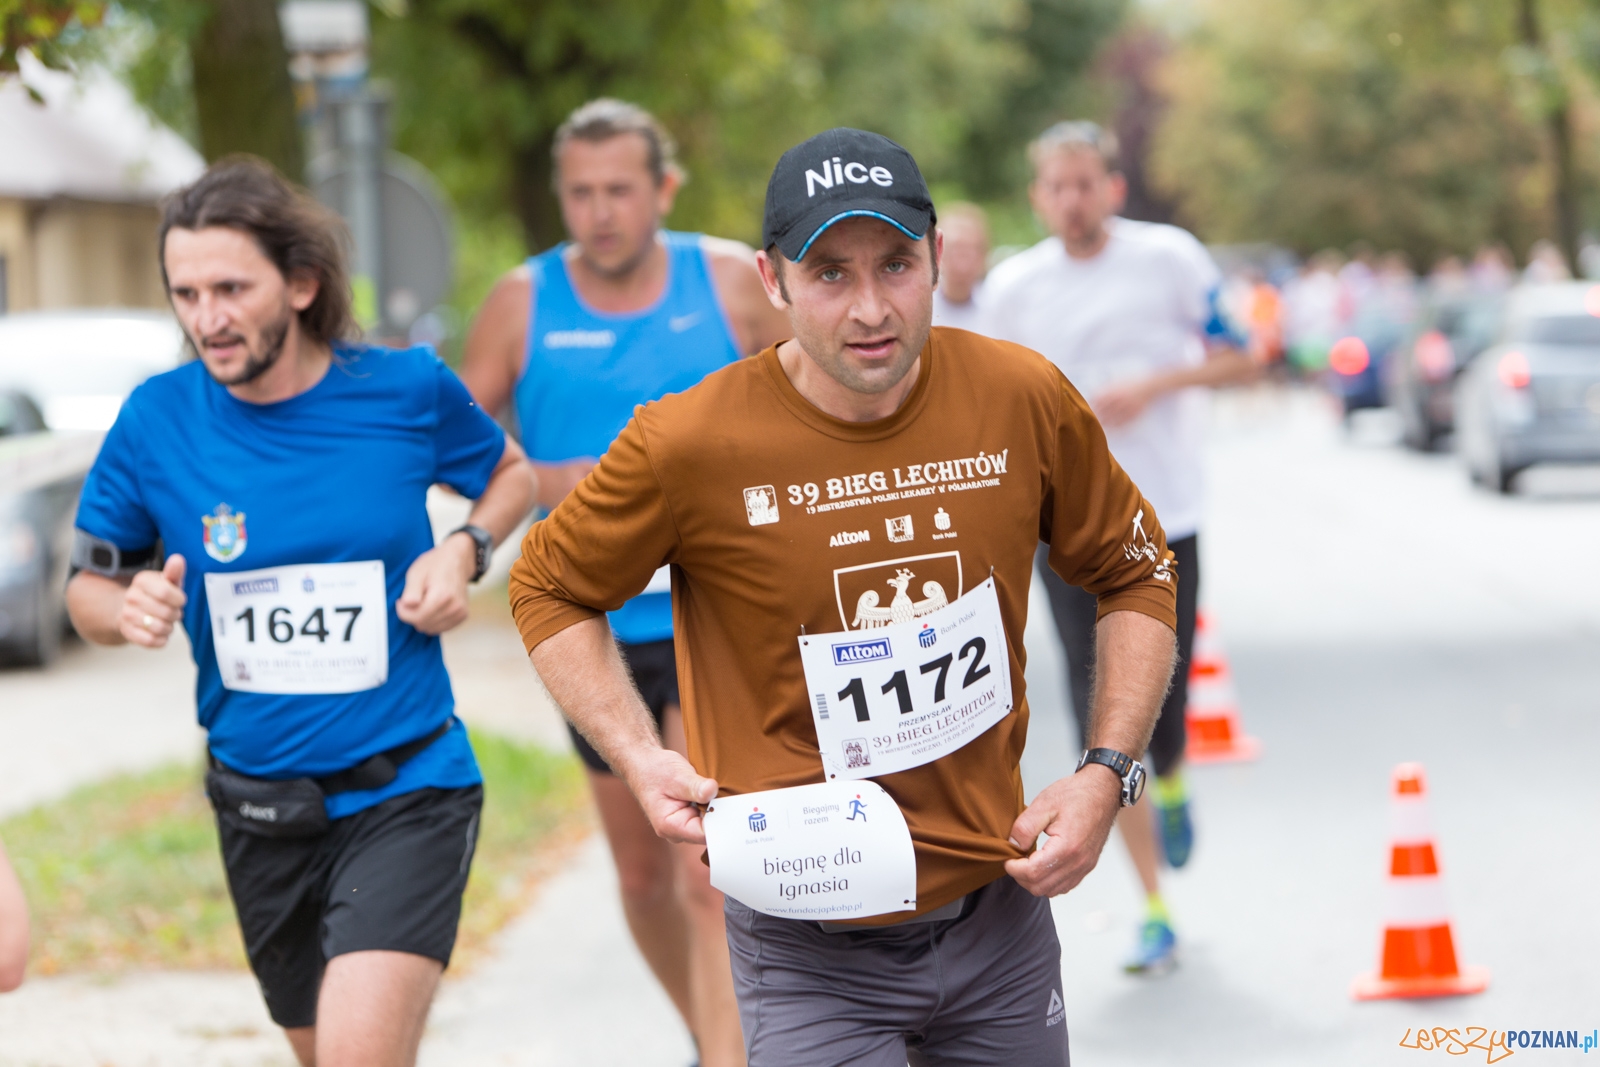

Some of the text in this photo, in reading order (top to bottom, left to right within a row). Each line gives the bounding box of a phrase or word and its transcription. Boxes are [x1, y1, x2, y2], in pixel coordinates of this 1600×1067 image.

[805, 156, 893, 198] Nice
[787, 448, 1009, 506] 39 BIEG LECHITÓW
[806, 506, 816, 514] 19
[817, 496, 872, 513] MISTRZOSTWA
[872, 492, 900, 503] POLSKI
[900, 485, 936, 499] LEKARZY
[938, 484, 946, 493] W
[235, 606, 363, 643] 1647
[837, 636, 991, 723] 1172
[872, 685, 996, 748] 39 BIEG LECHITÓW
[898, 703, 953, 728] PRZEMYSŁAW
[802, 803, 840, 817] Biegajmy
[804, 814, 829, 826] razem
[763, 847, 862, 877] biegnę dla
[779, 876, 849, 901] Ignasia
[765, 902, 863, 914] www.fundacjapkobp.pl
